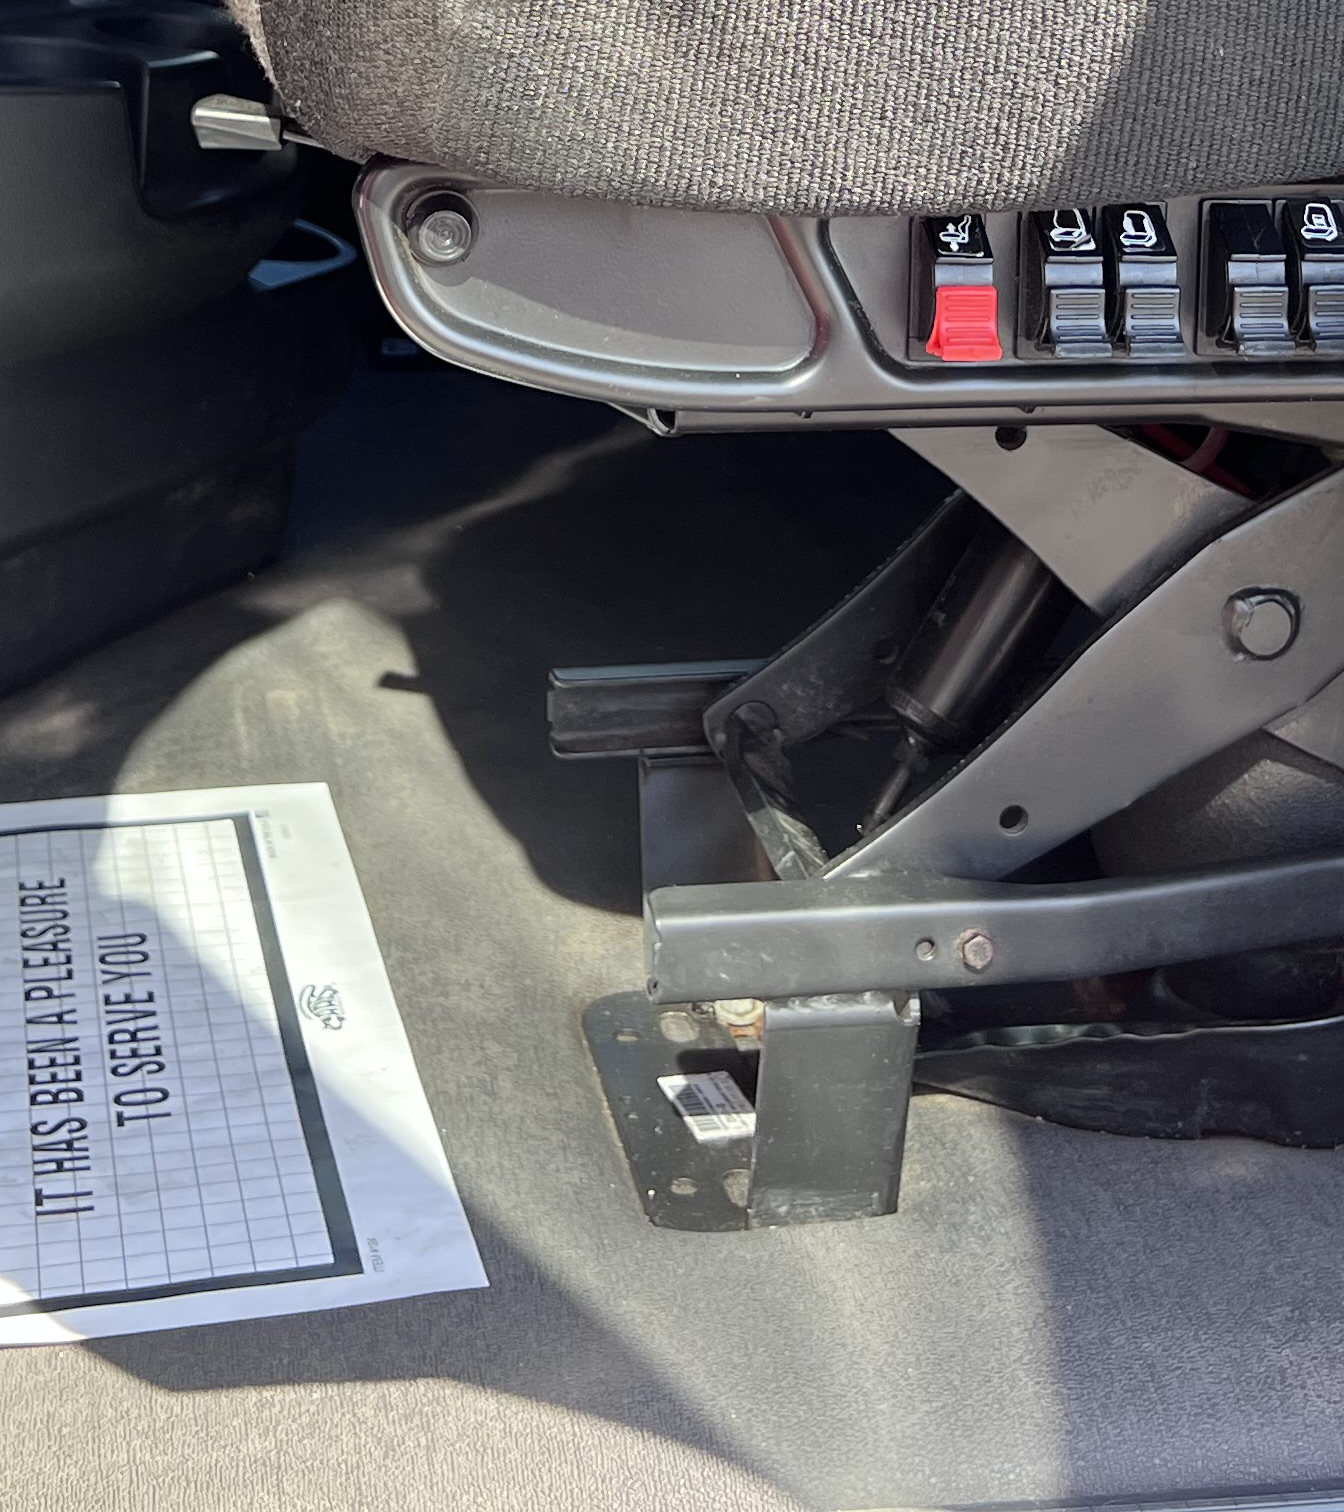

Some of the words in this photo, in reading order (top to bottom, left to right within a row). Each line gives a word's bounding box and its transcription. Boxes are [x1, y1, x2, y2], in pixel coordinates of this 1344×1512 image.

[18, 877, 76, 1002] PLEASURE
[97, 931, 152, 985] YOU
[25, 1008, 77, 1025] A
[104, 990, 166, 1078] SERVE
[26, 1036, 84, 1106] BEEN
[113, 1087, 172, 1128] TO
[30, 1116, 91, 1176] HAS
[35, 1188, 94, 1216] IT
